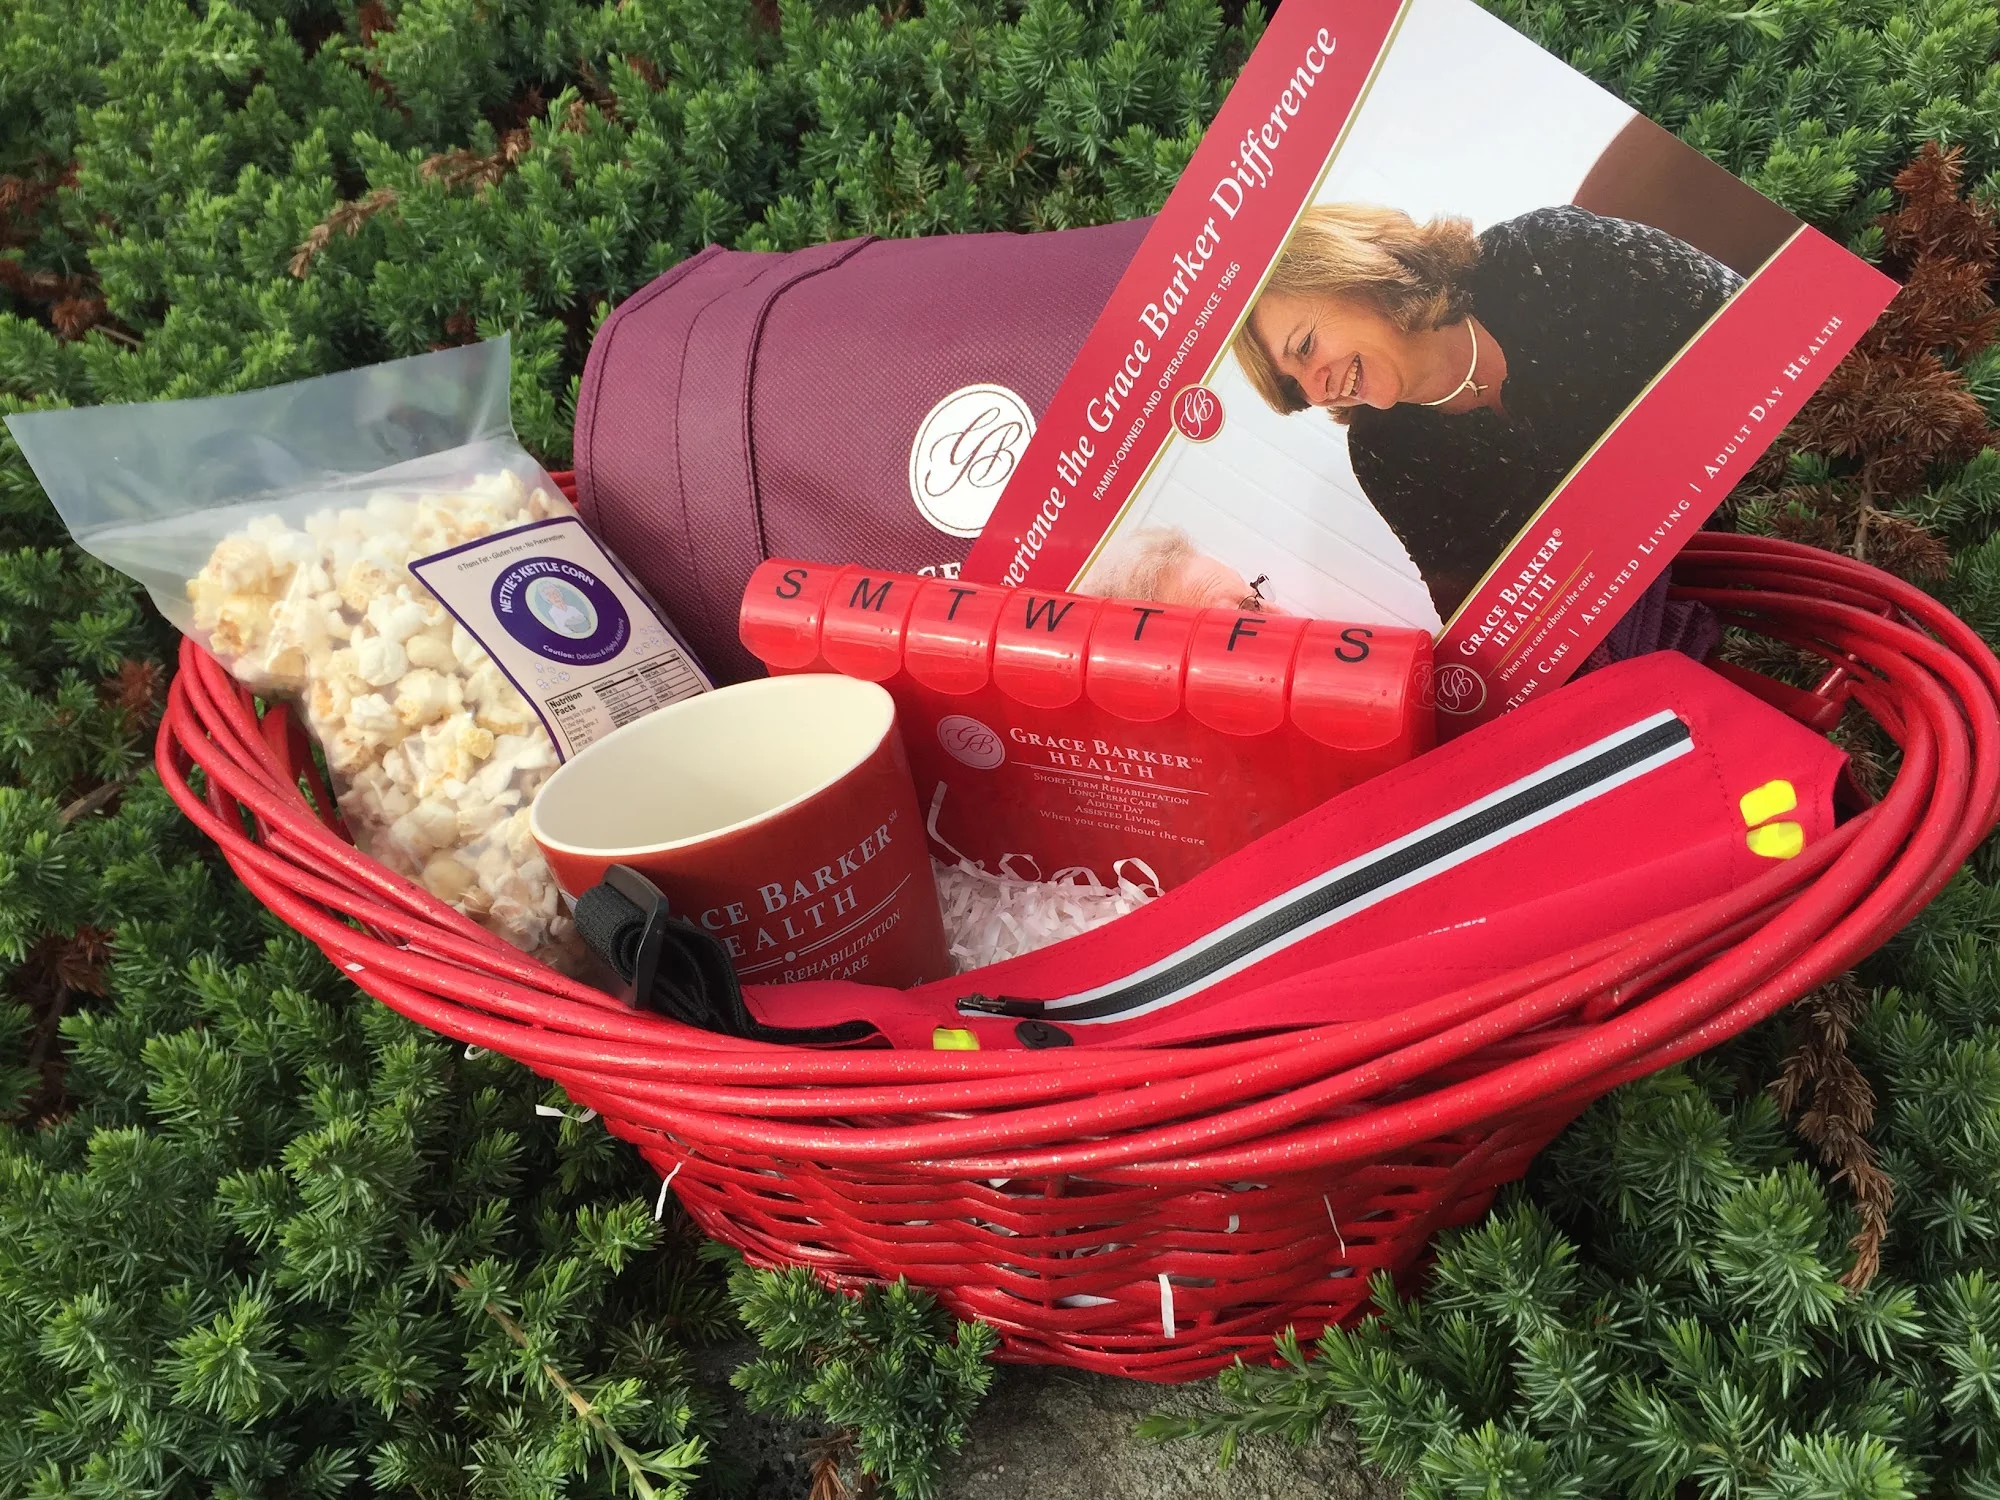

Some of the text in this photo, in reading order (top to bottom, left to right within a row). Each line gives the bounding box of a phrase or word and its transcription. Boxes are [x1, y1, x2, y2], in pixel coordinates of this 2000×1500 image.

[1001, 27, 1336, 587] perience the Grace Barker Difference
[1093, 261, 1241, 500] FAMILY-OWNED AND OPERATED SINCE 1966
[1537, 642, 1570, 674] CARE
[1580, 559, 1640, 626] ASSISTED
[1638, 498, 1690, 555] LIVING
[1703, 423, 1753, 480] ADULT
[1749, 385, 1785, 423] DAY
[1782, 315, 1844, 382] HEALTH
[491, 549, 511, 560] Gluten
[510, 545, 522, 554] Free
[500, 562, 595, 613] NETTIE'S KETTLE CORN
[775, 569, 1373, 663] S M T W T F S
[1459, 604, 1507, 656] GRACE
[1492, 573, 1557, 647] HEALTH
[1500, 571, 1595, 682] When you care about the care
[543, 644, 575, 659] Caution:
[549, 692, 583, 708] Nutrition
[554, 704, 576, 716] Facts
[1009, 727, 1086, 753] GRACE
[1092, 739, 1192, 769] BARKER
[1048, 751, 1154, 779] HEALTH
[1034, 772, 1189, 805] SHORT-TERM REHABILITATION
[1068, 786, 1158, 809] LONG-TERM CARE
[1086, 799, 1144, 815] ADULT DAY
[1040, 809, 1205, 846] When you care about the care
[1075, 805, 1161, 827] ASSISTED LIVING
[757, 823, 892, 914] BARKER
[722, 886, 858, 958] EALTH
[783, 908, 901, 983] REHABILITATION
[830, 954, 869, 980] CARE
